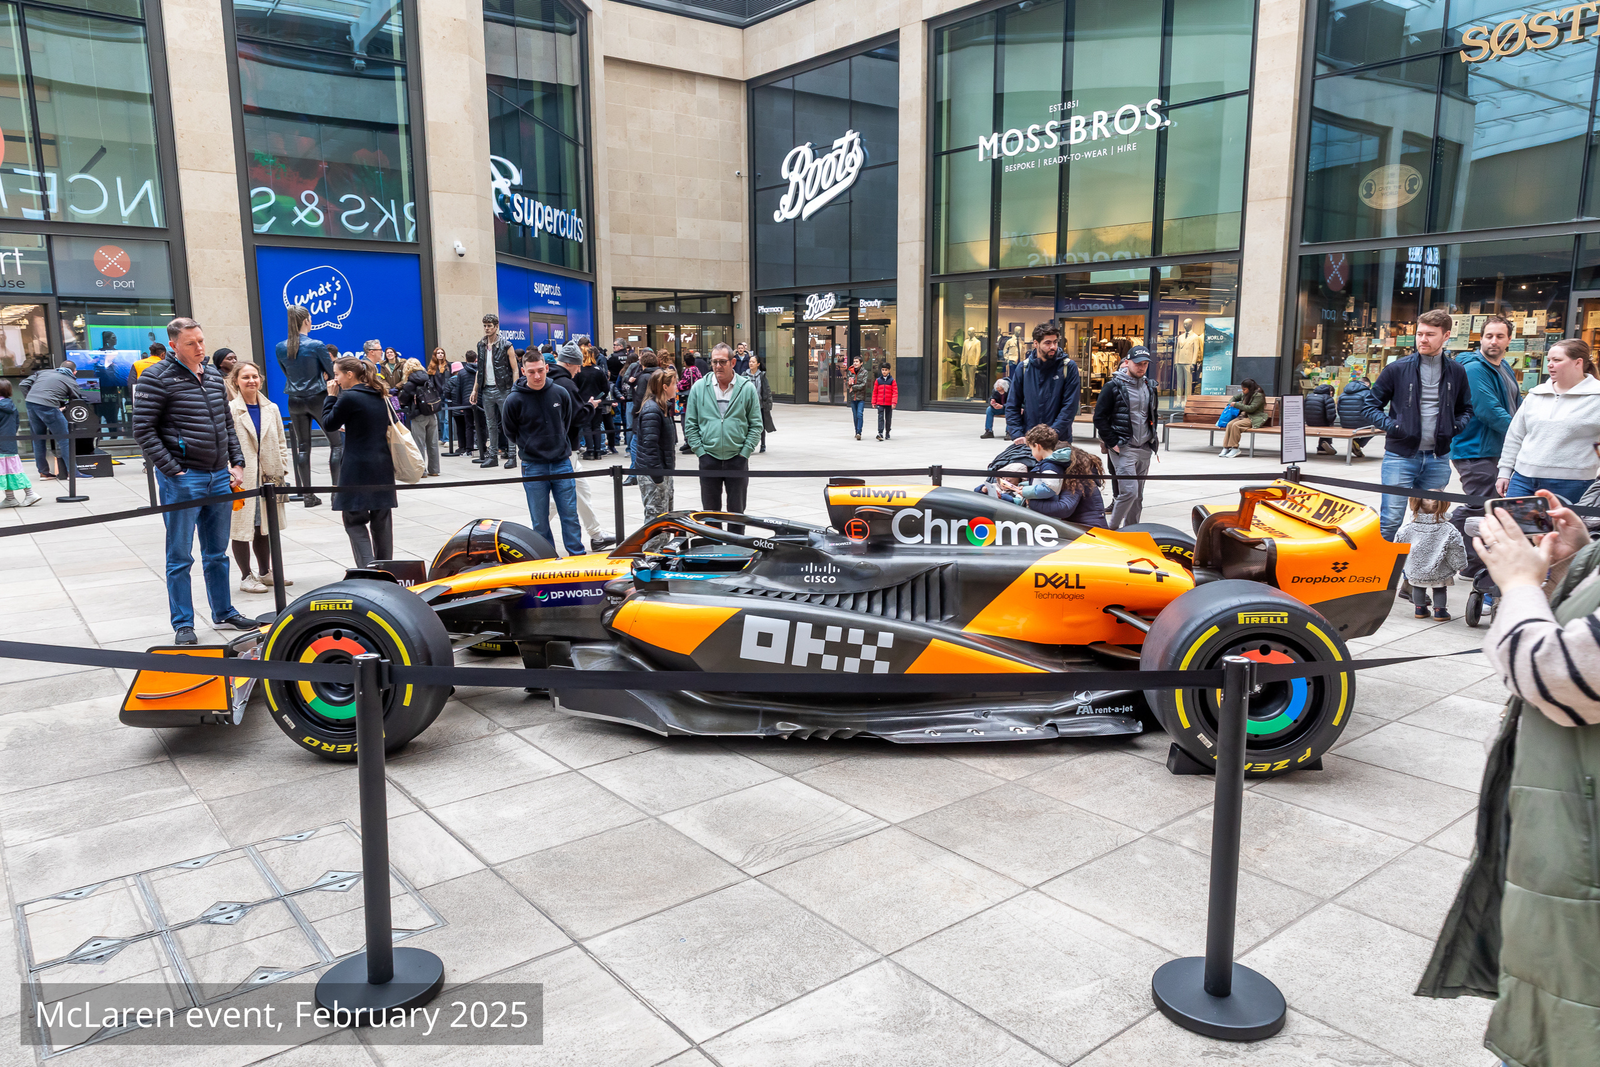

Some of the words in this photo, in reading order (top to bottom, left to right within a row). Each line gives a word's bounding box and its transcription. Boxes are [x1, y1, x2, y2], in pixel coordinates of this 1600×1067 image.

[1459, 0, 1600, 63] SØST
[1049, 99, 1079, 113] EST.1851
[978, 120, 1059, 162] MOSS
[1069, 98, 1171, 145] BROS.
[1004, 160, 1035, 173] BESPOKE
[1043, 148, 1107, 166] READY-TO-WEAR
[1117, 142, 1137, 154] HIRE
[773, 129, 866, 222] Boots
[512, 192, 584, 244] supercuts
[758, 306, 784, 315] Pharmacy
[802, 292, 836, 321] Boots
[859, 299, 882, 309] Beauty
[850, 487, 907, 503] allwyn
[891, 508, 1060, 548] Chrome
[753, 539, 774, 551] okta
[531, 570, 580, 580] RICHARD
[584, 568, 618, 578] MILLE
[1034, 572, 1086, 589] DELL
[1291, 575, 1347, 585] Dropbox
[1348, 575, 1381, 584] Dash
[550, 590, 565, 600] DP
[565, 588, 604, 598] WORLD
[1034, 591, 1085, 601] Technologies
[310, 599, 353, 612] PIRELLI
[1237, 611, 1289, 625] PIRELLI
[1095, 705, 1133, 714] rent-a-jet
